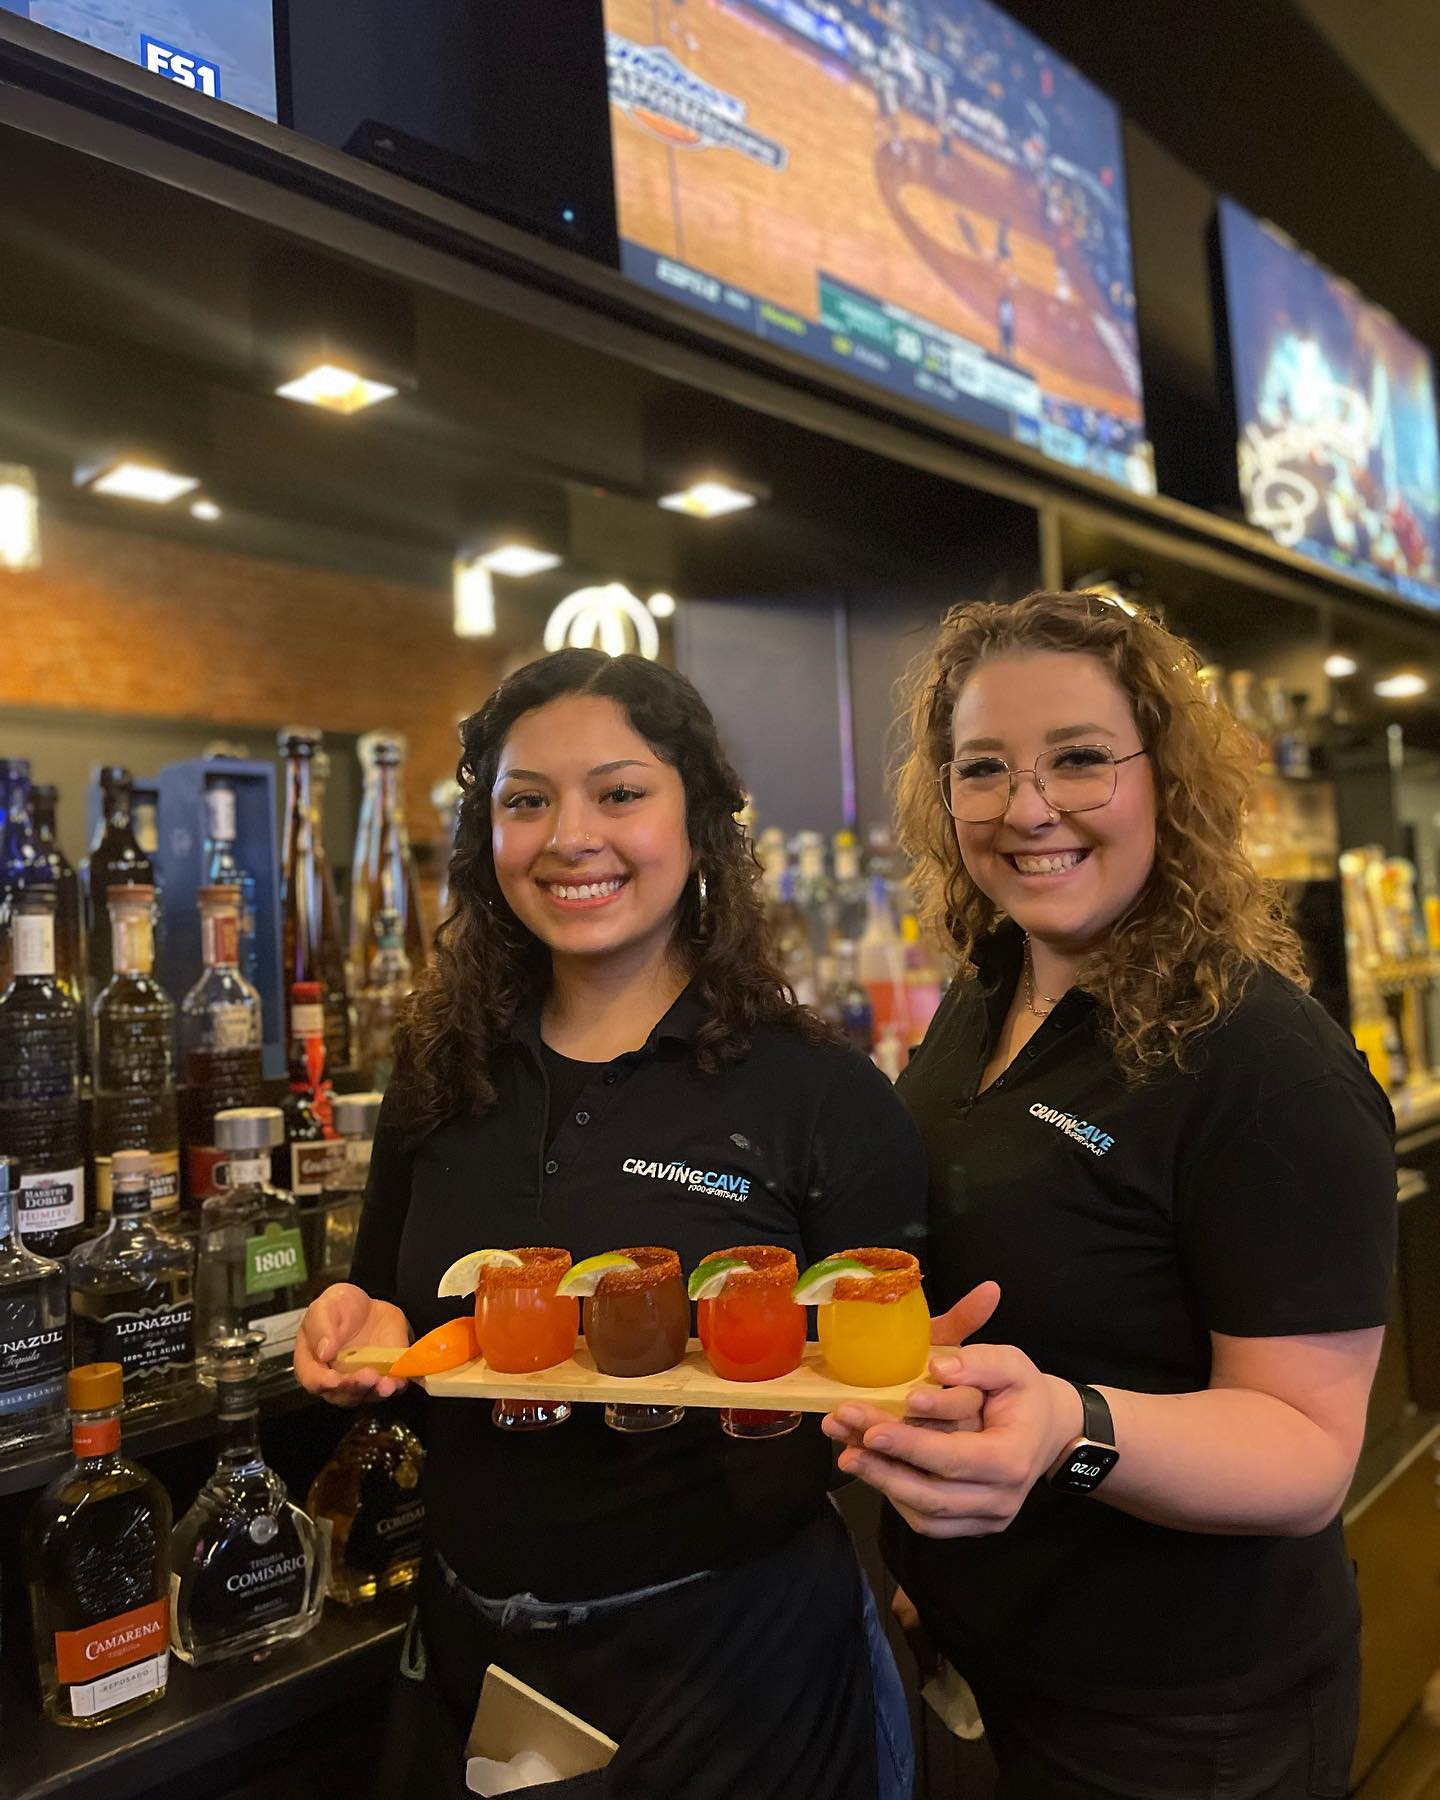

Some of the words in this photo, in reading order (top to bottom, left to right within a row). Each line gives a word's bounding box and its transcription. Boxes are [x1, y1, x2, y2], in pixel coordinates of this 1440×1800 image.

[147, 42, 216, 97] FS1
[25, 1195, 66, 1209] DOBEL
[255, 1247, 297, 1273] 1800
[116, 1311, 191, 1335] LUNAZUL
[0, 1332, 62, 1354] NAZUL
[226, 1554, 308, 1592] COMISARIO
[85, 1621, 161, 1661] CAMARENA
